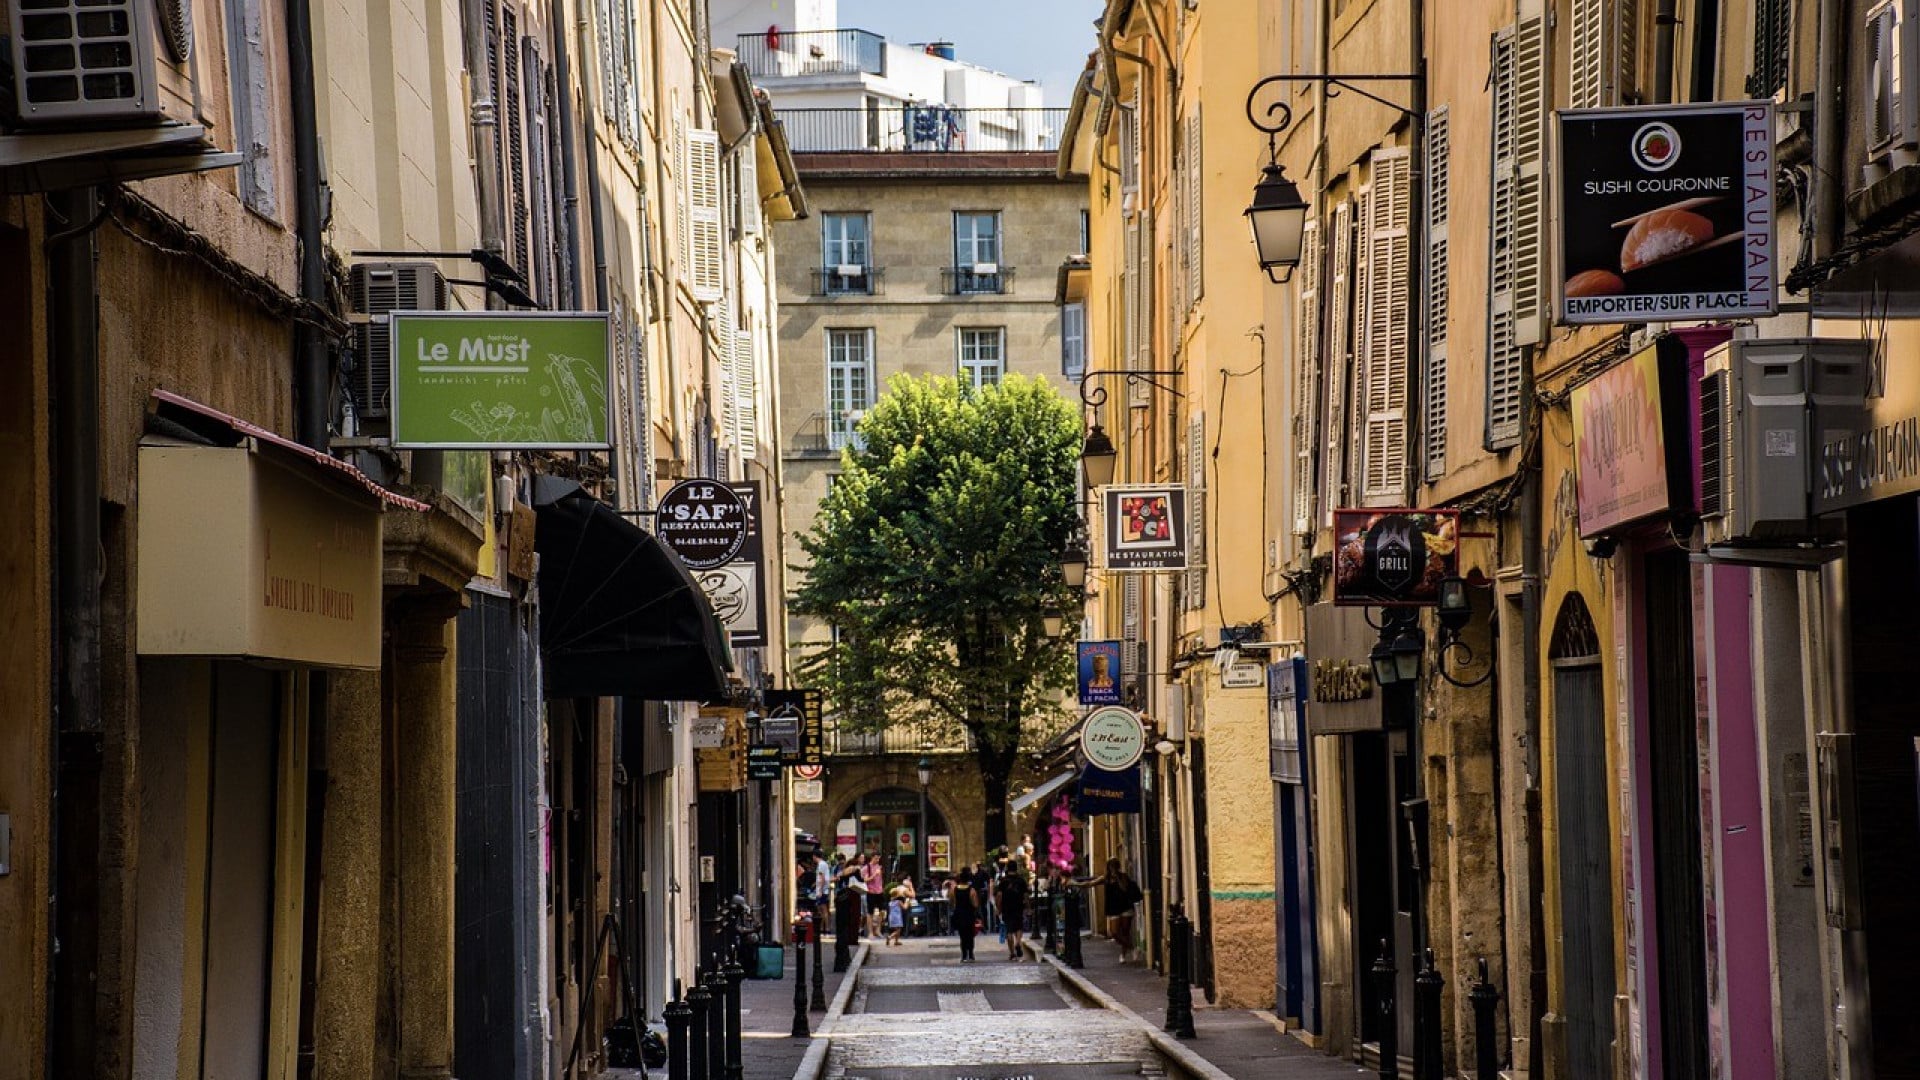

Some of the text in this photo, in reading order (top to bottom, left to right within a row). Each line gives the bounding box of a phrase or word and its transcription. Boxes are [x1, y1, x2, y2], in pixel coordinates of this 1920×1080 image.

[1584, 177, 1731, 194] SUSHI COURONNE
[1745, 106, 1770, 310] RESTAURANT
[1567, 293, 1748, 314] EMPORTER/SUR PLACE
[418, 337, 531, 362] Le Must
[688, 487, 715, 500] LE
[661, 522, 742, 530] RESTAURANT
[1109, 551, 1185, 559] RESTAURATION
[1379, 557, 1408, 571] GRILL
[804, 692, 820, 763] PRESSING
